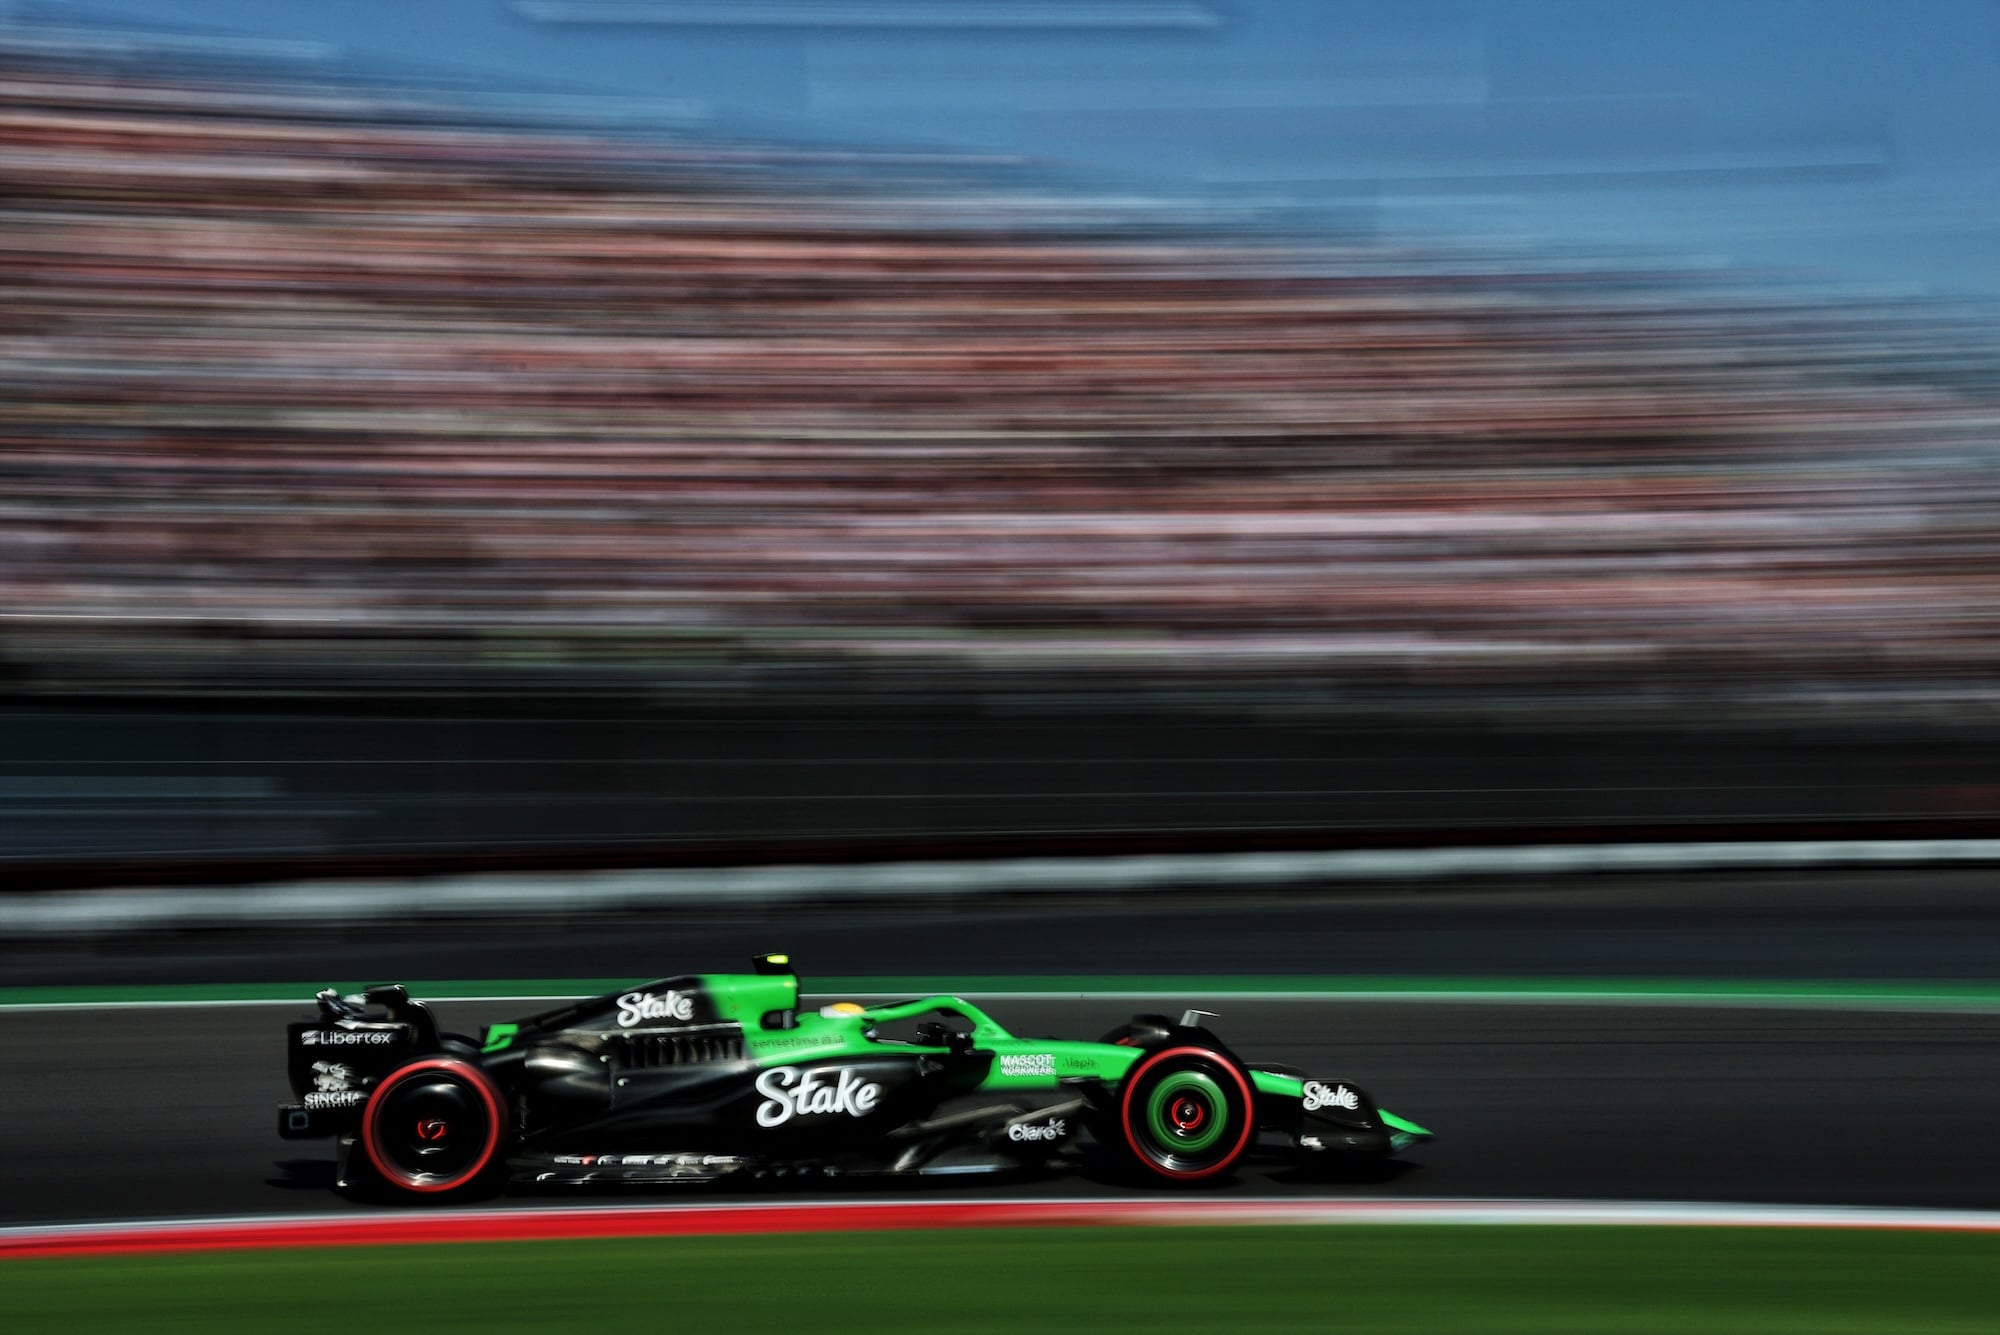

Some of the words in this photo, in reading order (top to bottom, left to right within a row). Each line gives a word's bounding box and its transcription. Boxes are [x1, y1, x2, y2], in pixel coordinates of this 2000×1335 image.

[616, 990, 695, 1028] Stake
[320, 1031, 391, 1045] Libertex
[752, 1036, 819, 1049] sensetime
[1000, 1054, 1056, 1067] MASCOT
[755, 1065, 882, 1128] Stake
[1302, 1080, 1360, 1111] Stake
[1008, 1123, 1057, 1142] Claro
